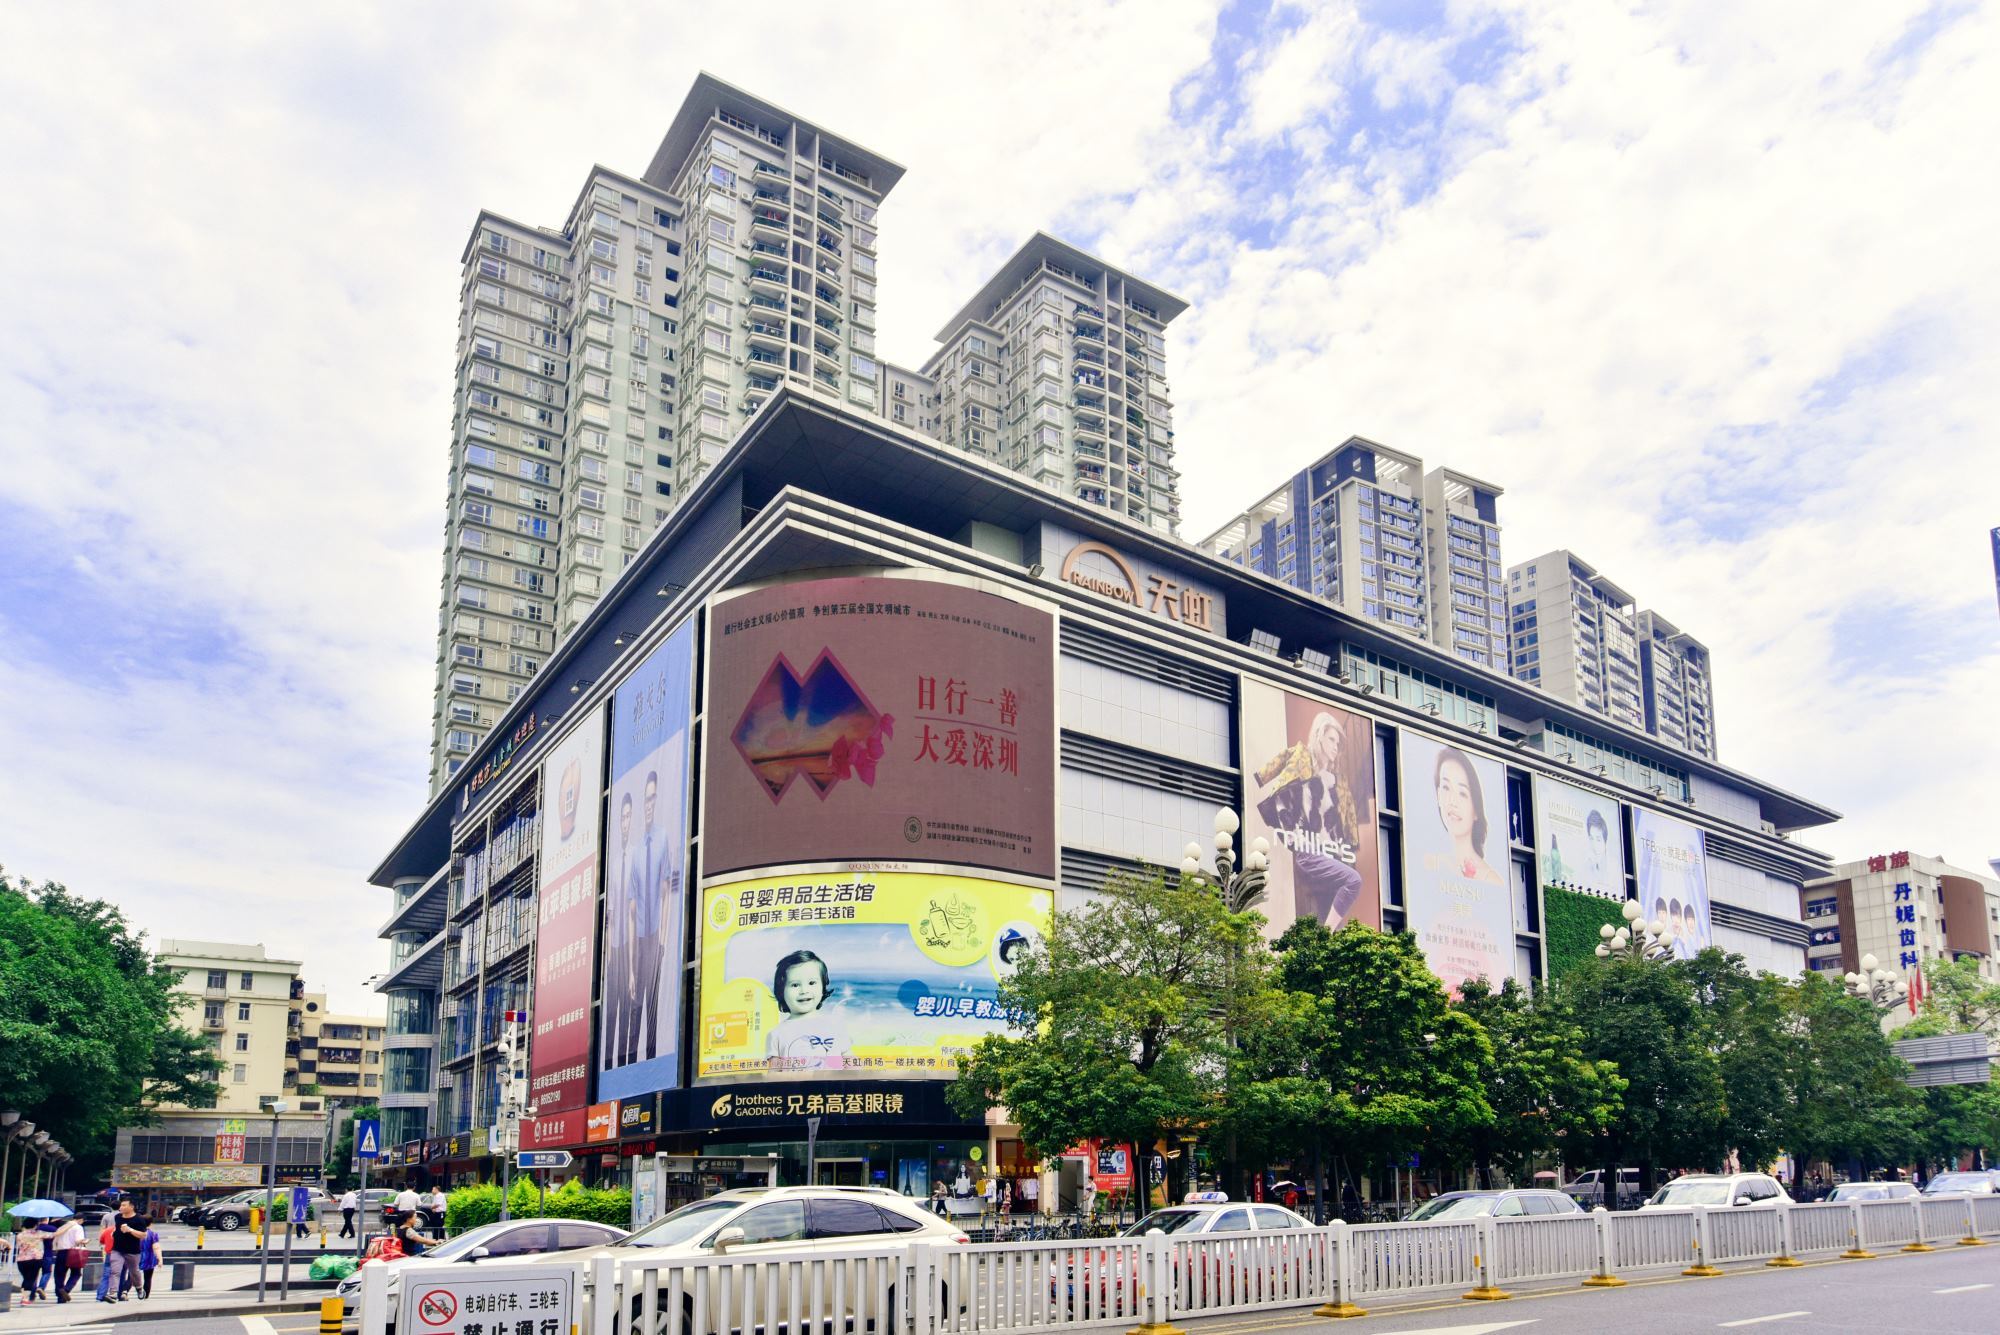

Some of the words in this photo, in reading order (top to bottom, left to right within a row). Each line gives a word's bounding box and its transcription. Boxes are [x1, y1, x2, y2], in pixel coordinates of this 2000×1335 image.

[1072, 571, 1136, 604] RAINBOW
[1148, 573, 1216, 632] 天虹
[917, 674, 1019, 728] 日行一善
[539, 865, 594, 928] 红苹果家具
[738, 882, 876, 909] 母婴用品生活馆
[738, 909, 783, 927] 可爱可亲
[787, 905, 855, 922] 美合生活馆
[1894, 883, 1919, 970] 丹妮齿科
[735, 1094, 783, 1106] brothers
[735, 1106, 783, 1117] GAODENG
[786, 1093, 904, 1115] 兄弟高登眼镜
[464, 1291, 560, 1314] 电动自行车、三轮车
[463, 1318, 560, 1335] 禁止通行
